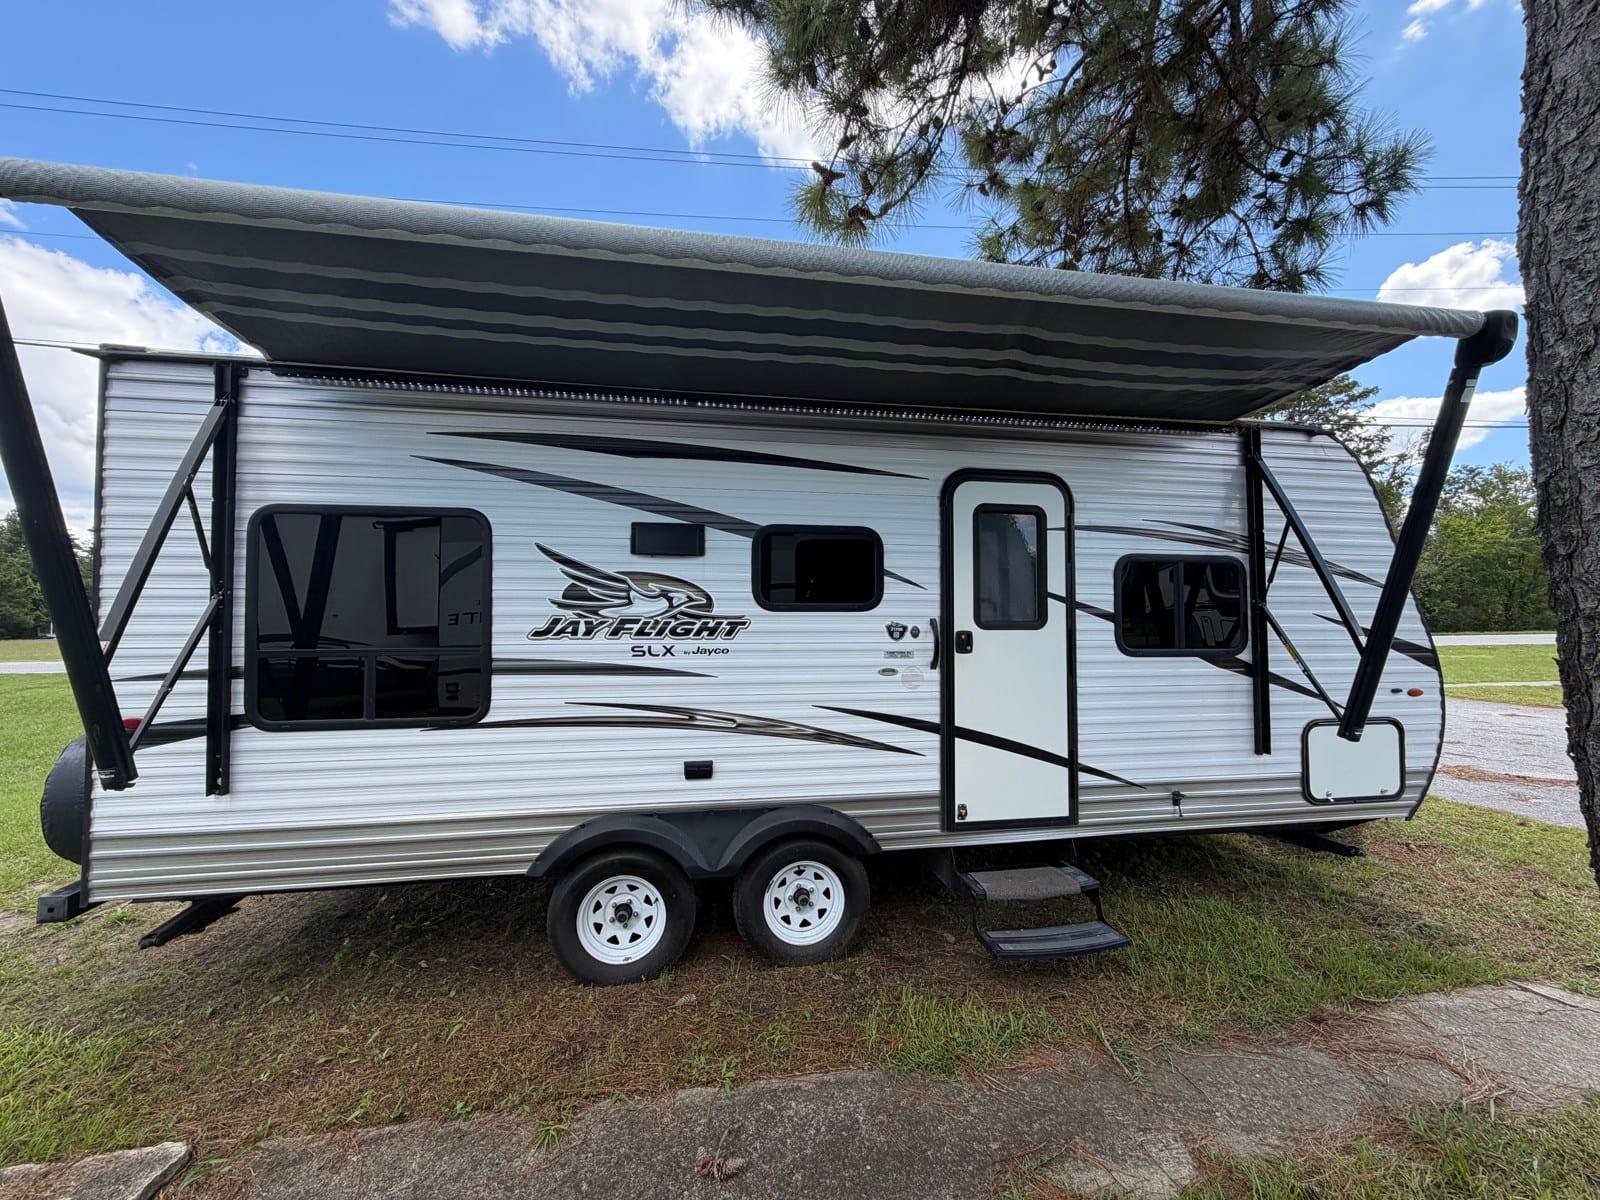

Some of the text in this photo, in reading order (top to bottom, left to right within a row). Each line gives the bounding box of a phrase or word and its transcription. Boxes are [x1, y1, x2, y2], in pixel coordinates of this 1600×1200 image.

[528, 615, 750, 640] JAY FLIGHT
[631, 645, 676, 658] SLX
[692, 646, 730, 657] Jayco
